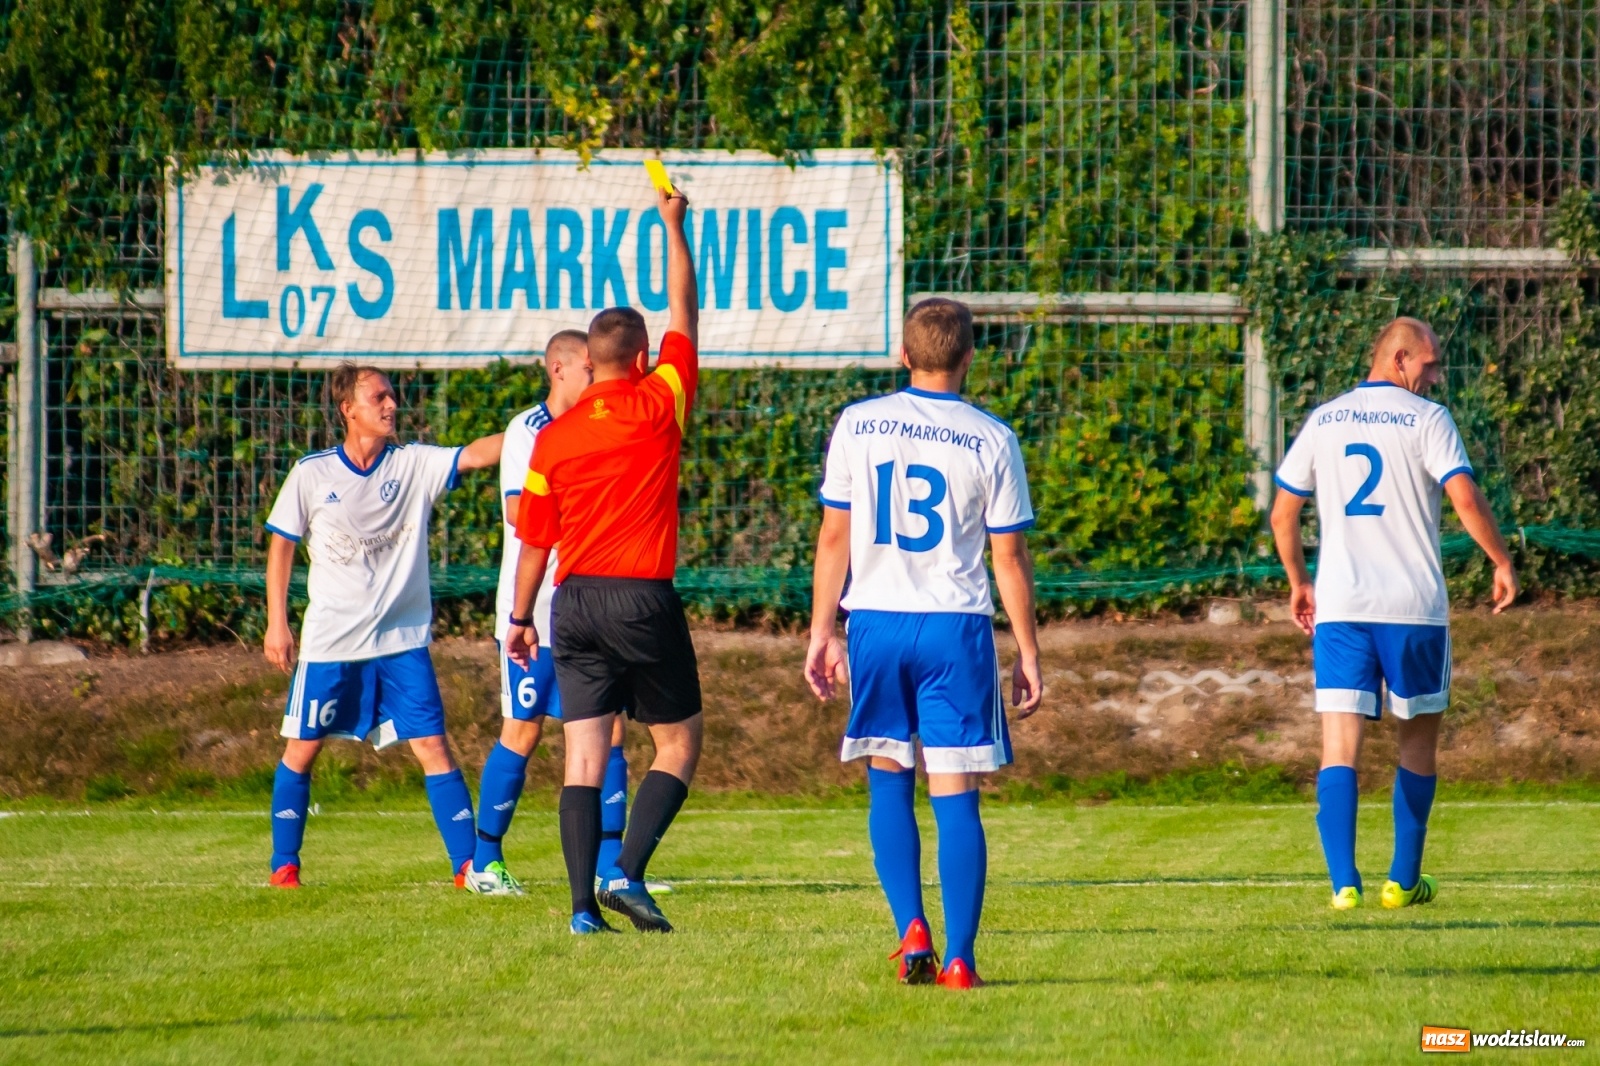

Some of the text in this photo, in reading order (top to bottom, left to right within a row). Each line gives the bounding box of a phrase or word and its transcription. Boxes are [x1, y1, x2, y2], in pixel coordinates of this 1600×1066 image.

[222, 183, 848, 320] LKS MARKOWICE
[279, 284, 336, 338] 07
[1318, 411, 1333, 426] LKS
[1352, 410, 1417, 427] MARKOWICE
[855, 419, 876, 435] LKS
[900, 422, 985, 453] MARKOWICE
[1345, 442, 1386, 516] 2
[873, 460, 947, 553] 13
[517, 676, 538, 709] 6
[307, 698, 338, 729] 16
[608, 877, 630, 891] NIKE
